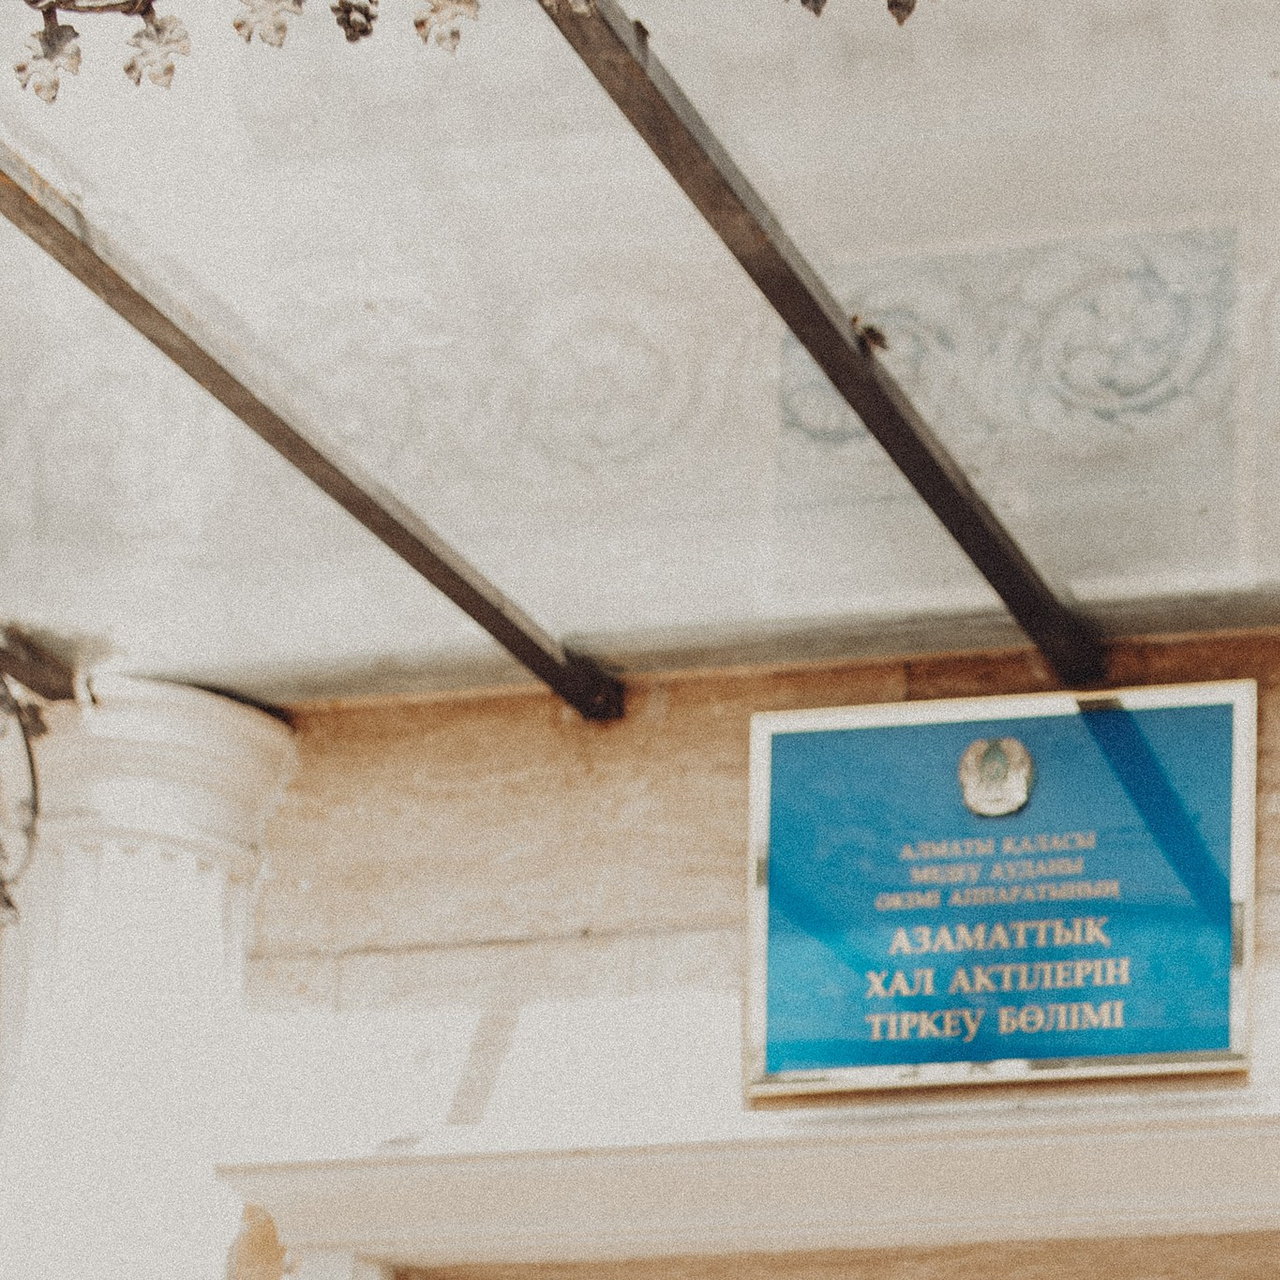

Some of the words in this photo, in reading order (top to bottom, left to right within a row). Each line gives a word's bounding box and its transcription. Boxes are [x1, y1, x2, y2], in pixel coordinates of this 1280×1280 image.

[888, 915, 1111, 956] АЗАМАТТЫҚ
[866, 968, 934, 999] ХАЛ
[948, 956, 1130, 995] АКТІЛЕРІН
[864, 1007, 985, 1043] ТІРКЕУ
[998, 1000, 1125, 1035] БӨЛІМІ
